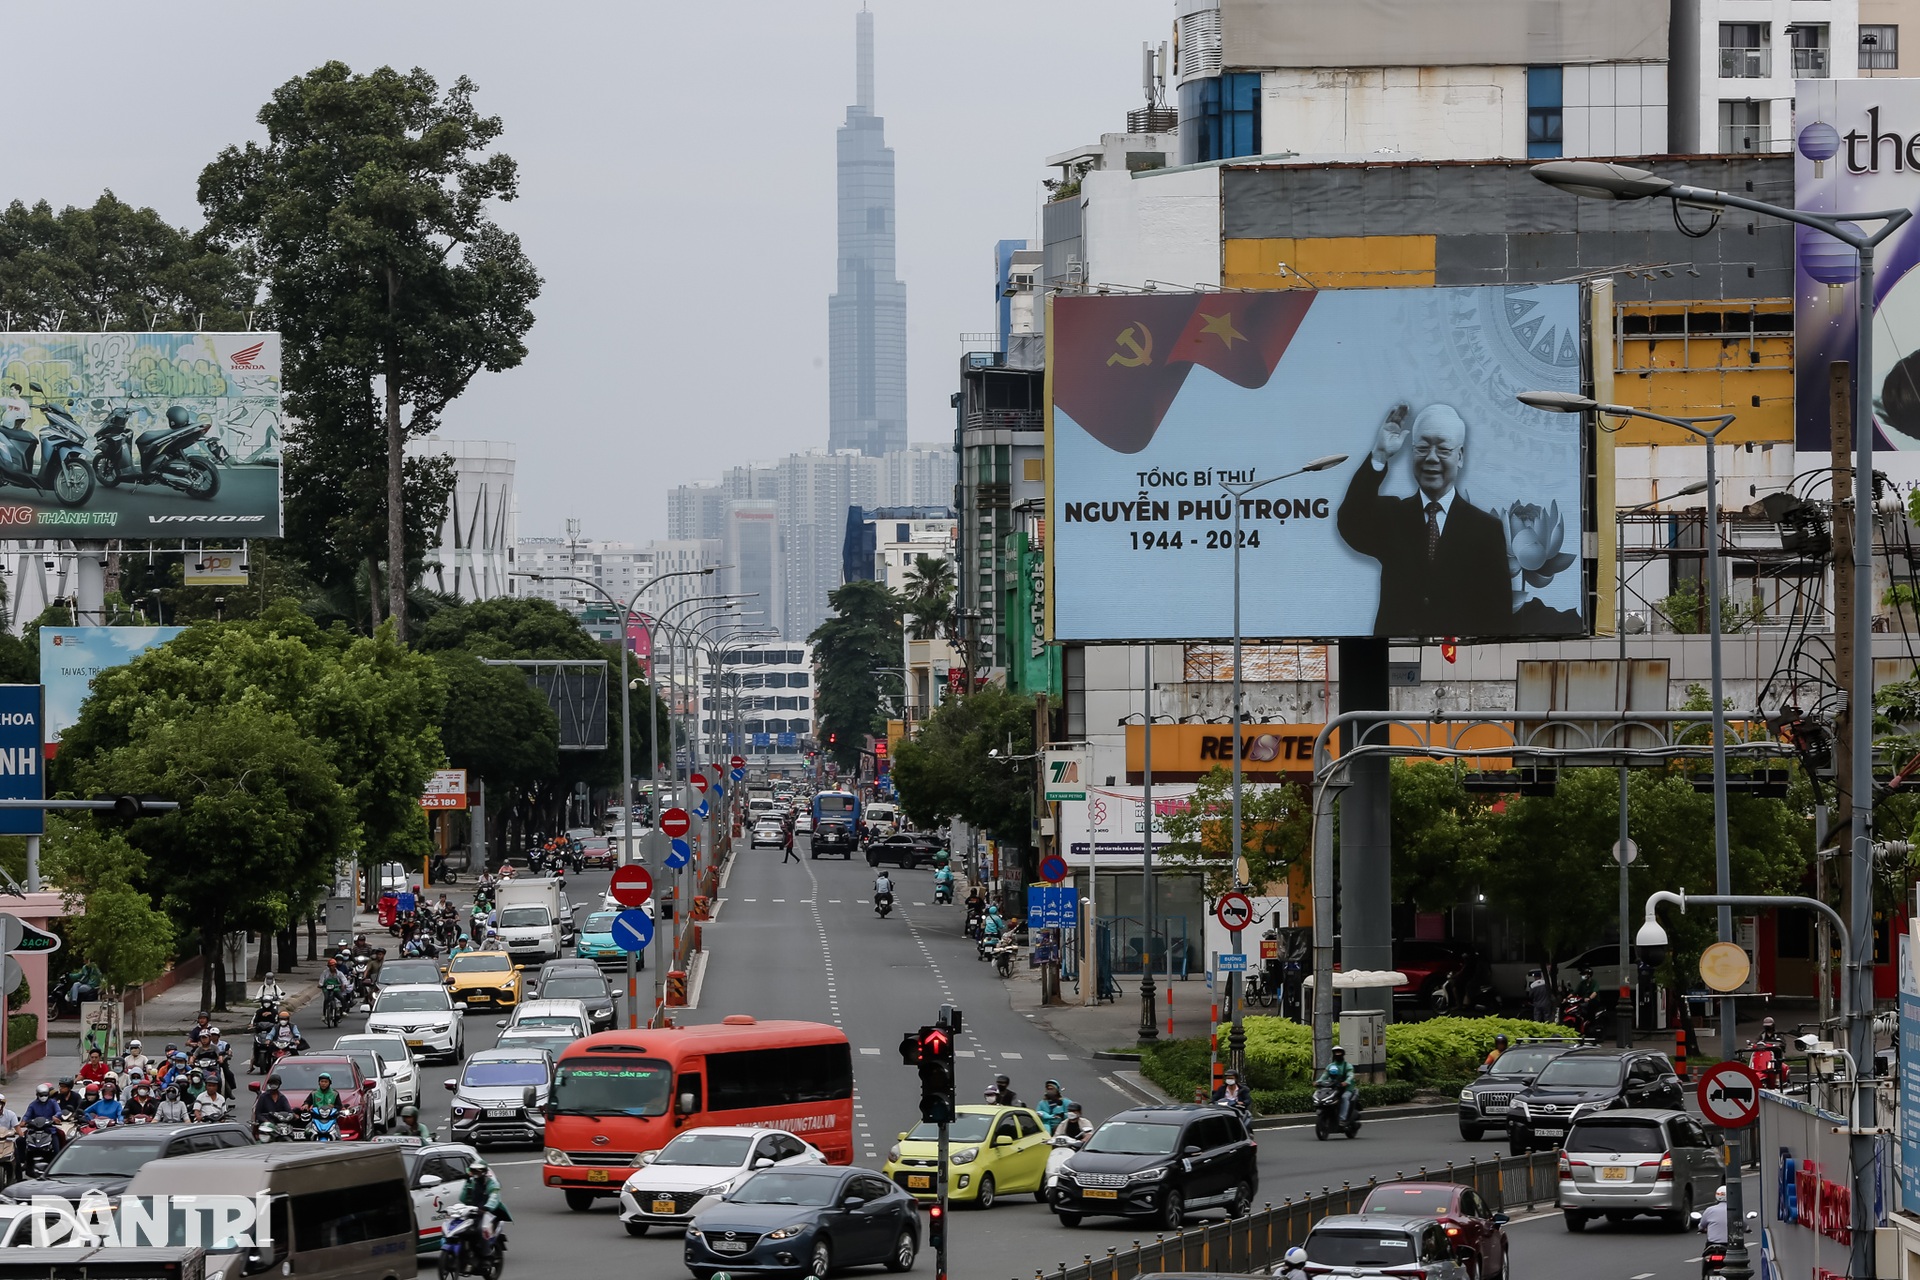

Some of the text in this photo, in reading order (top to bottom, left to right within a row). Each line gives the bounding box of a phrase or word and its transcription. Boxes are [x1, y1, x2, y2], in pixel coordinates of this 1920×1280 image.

[1136, 466, 1256, 487] TỔNG BÍ THƯ
[37, 509, 91, 525] THÀNH
[93, 512, 118, 527] THỊ
[1064, 491, 1330, 525] NGUYỄN PHÚ TRỌNG
[1130, 531, 1183, 550] 1944
[1206, 530, 1261, 549] 2024
[1031, 562, 1045, 658] WeTrek
[0, 713, 35, 726] HOA
